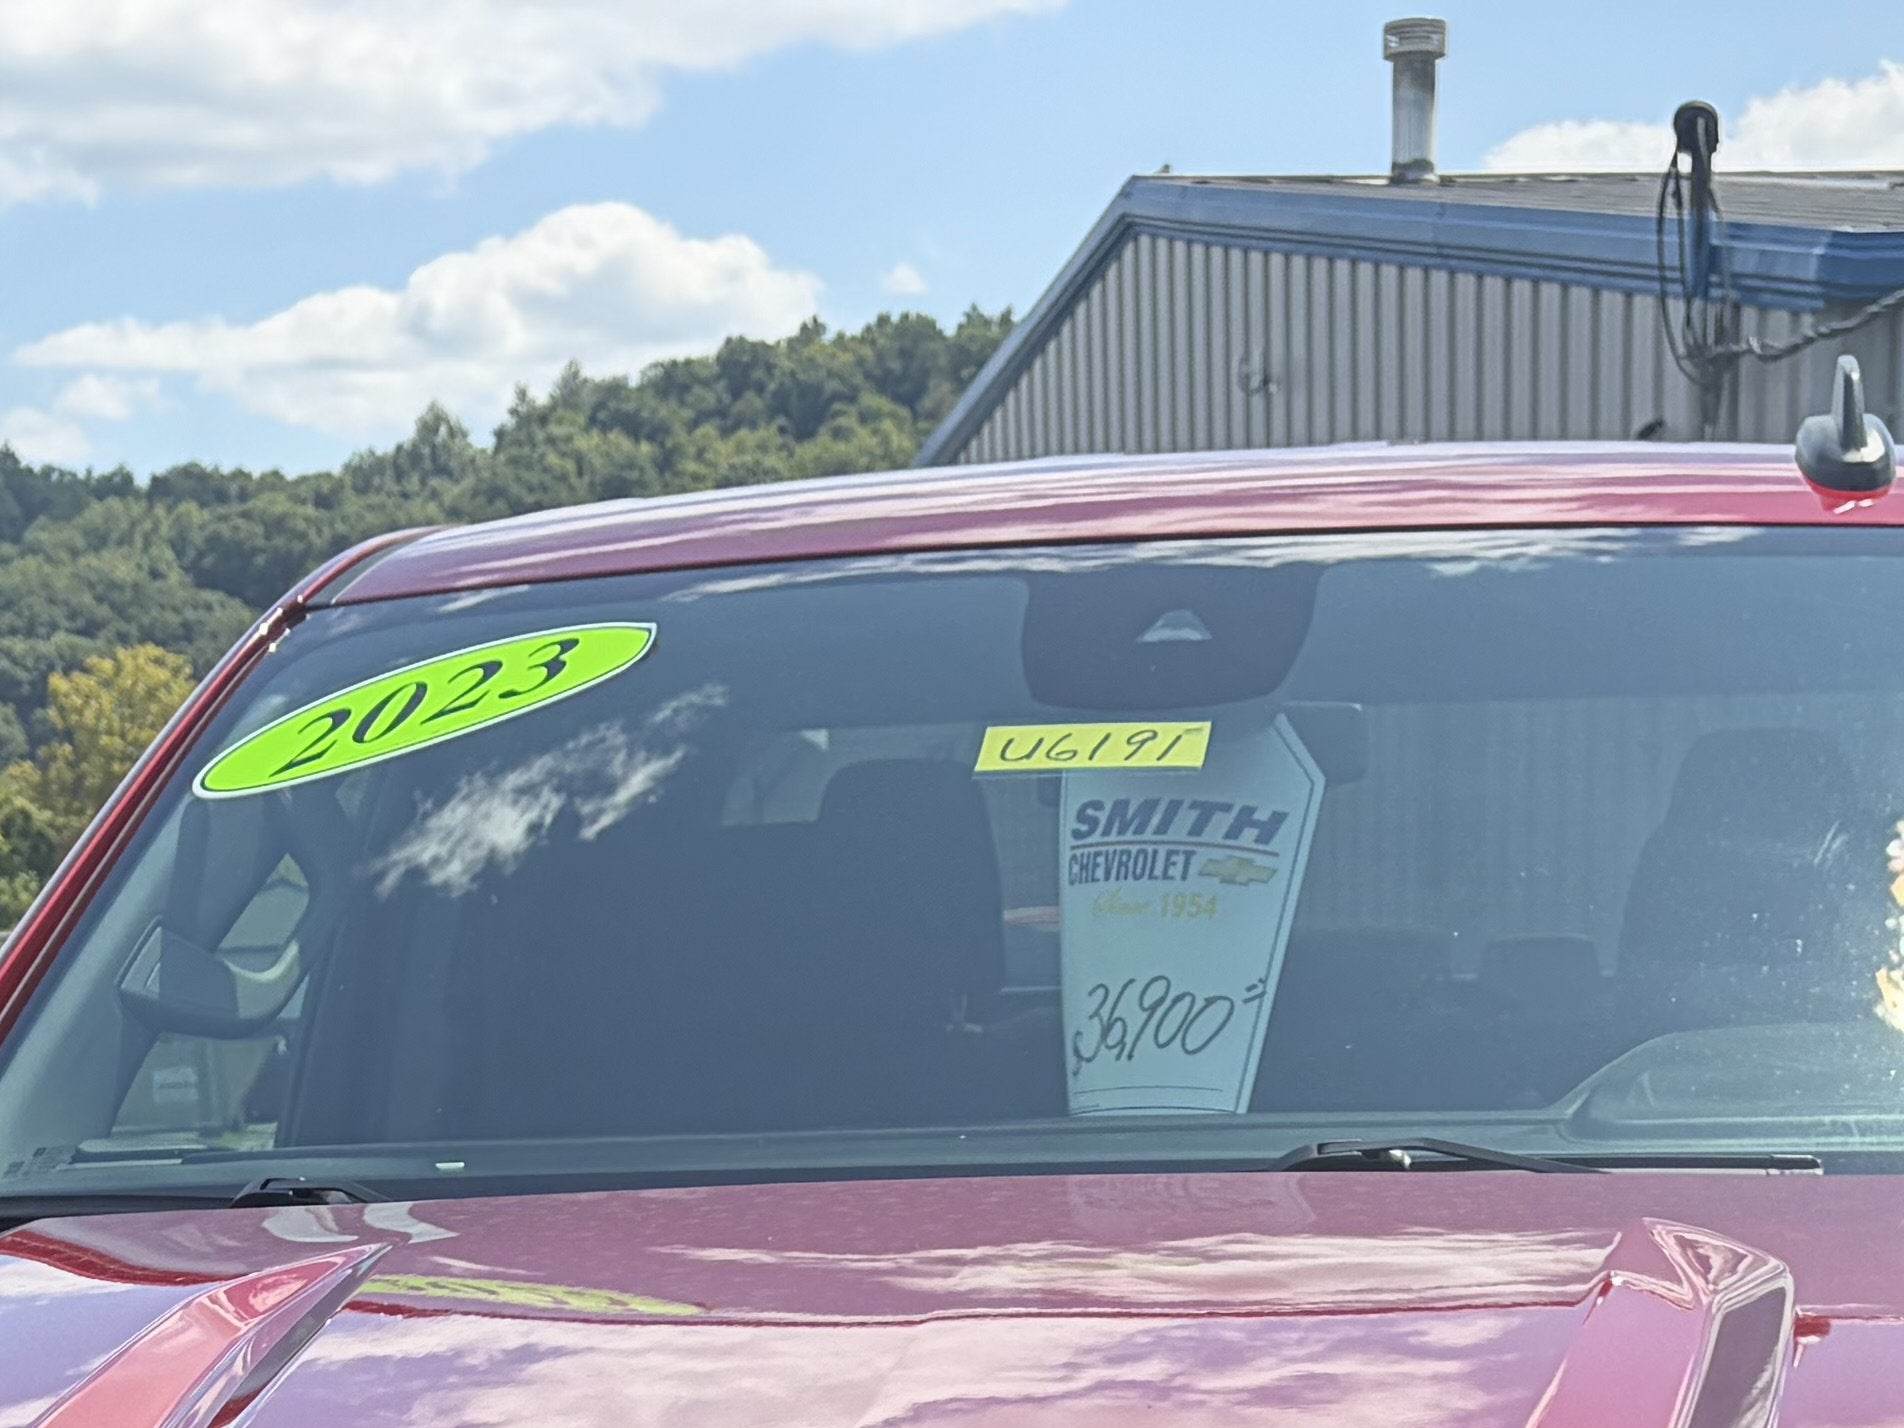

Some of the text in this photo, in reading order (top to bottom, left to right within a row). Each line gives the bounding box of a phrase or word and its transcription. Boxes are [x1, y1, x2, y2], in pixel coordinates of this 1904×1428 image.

[269, 637, 580, 778] 2023
[1070, 797, 1291, 846] SMITH
[1067, 848, 1198, 887] CHEVROLET
[1160, 891, 1218, 919] 1954
